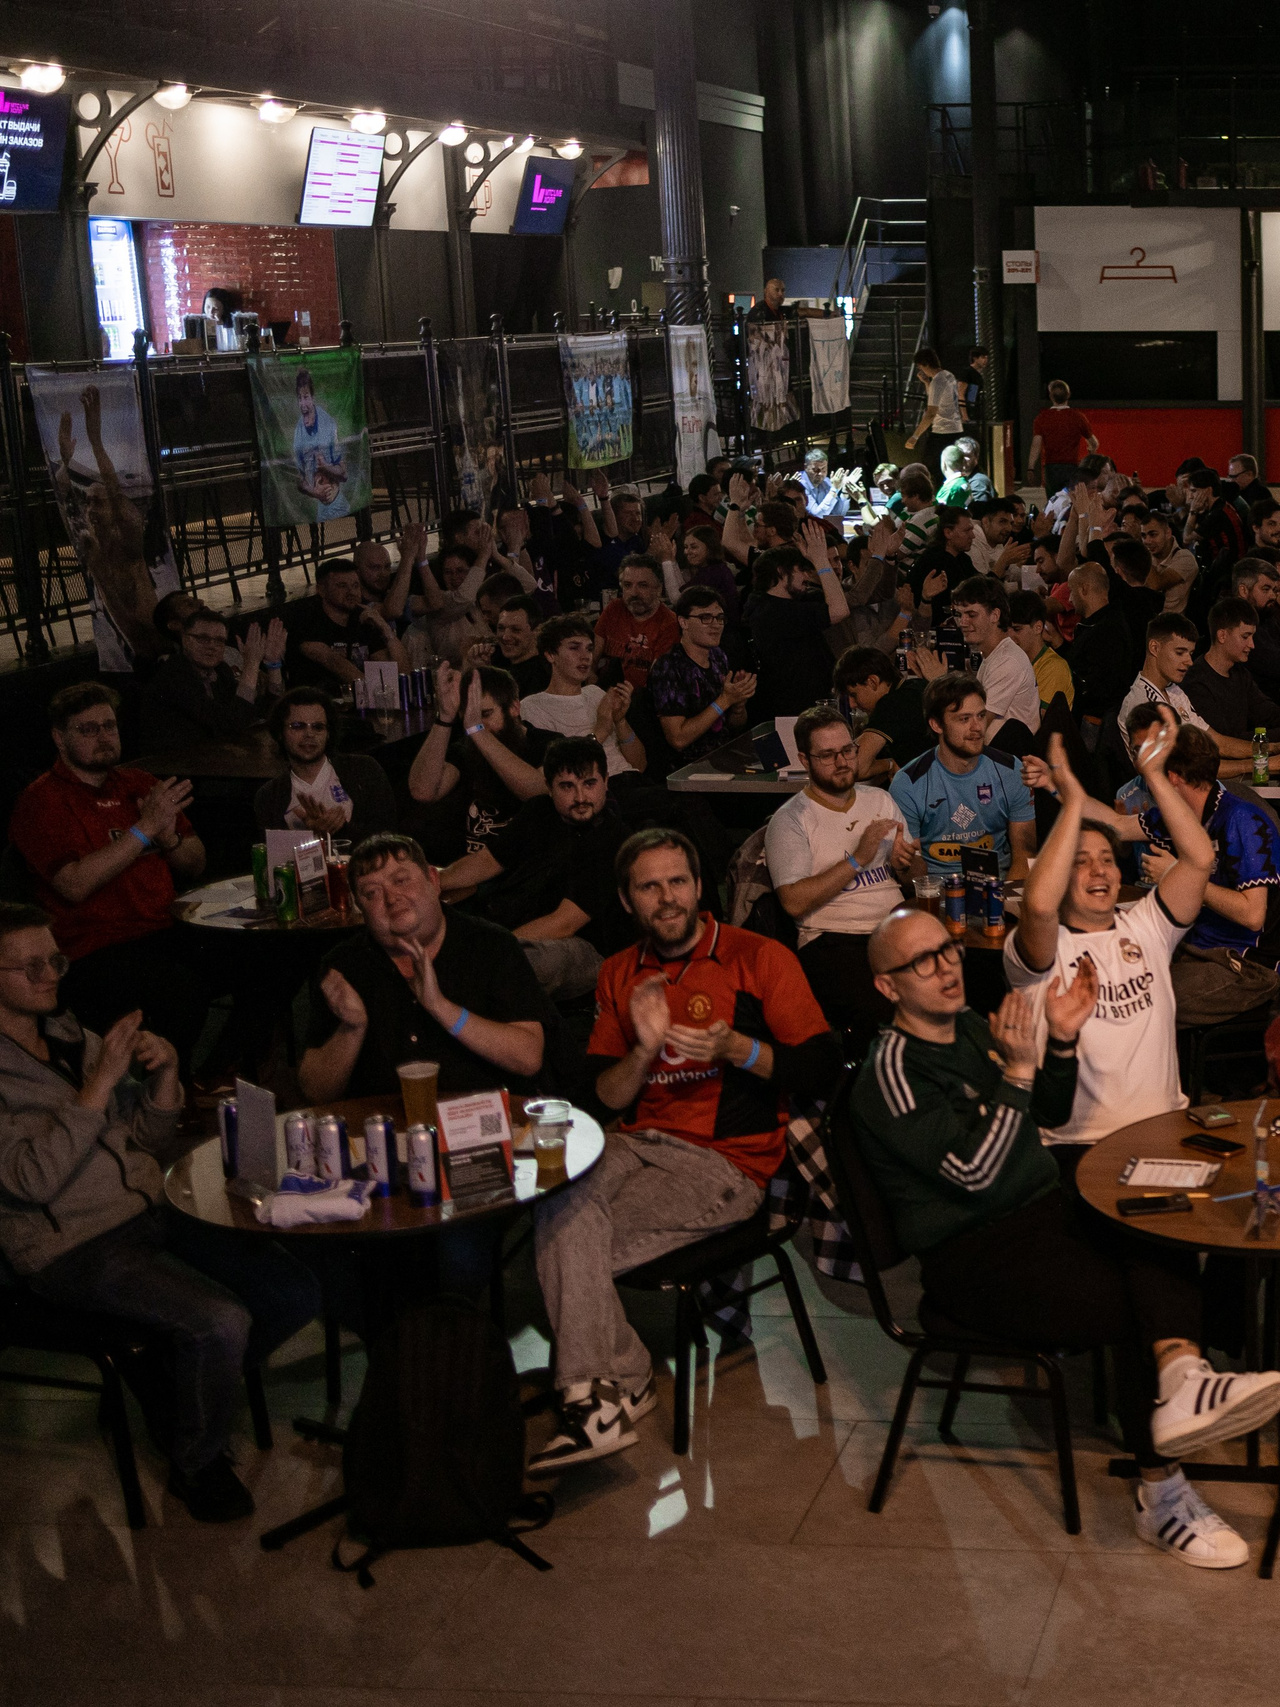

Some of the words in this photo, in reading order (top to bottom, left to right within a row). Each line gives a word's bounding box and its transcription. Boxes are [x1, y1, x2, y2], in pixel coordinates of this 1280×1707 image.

[8, 120, 41, 132] ВЫДАЧИ
[8, 135, 44, 147] ЗАКАЗОВ
[941, 829, 986, 841] azfargroup
[1111, 992, 1153, 1019] BETTER
